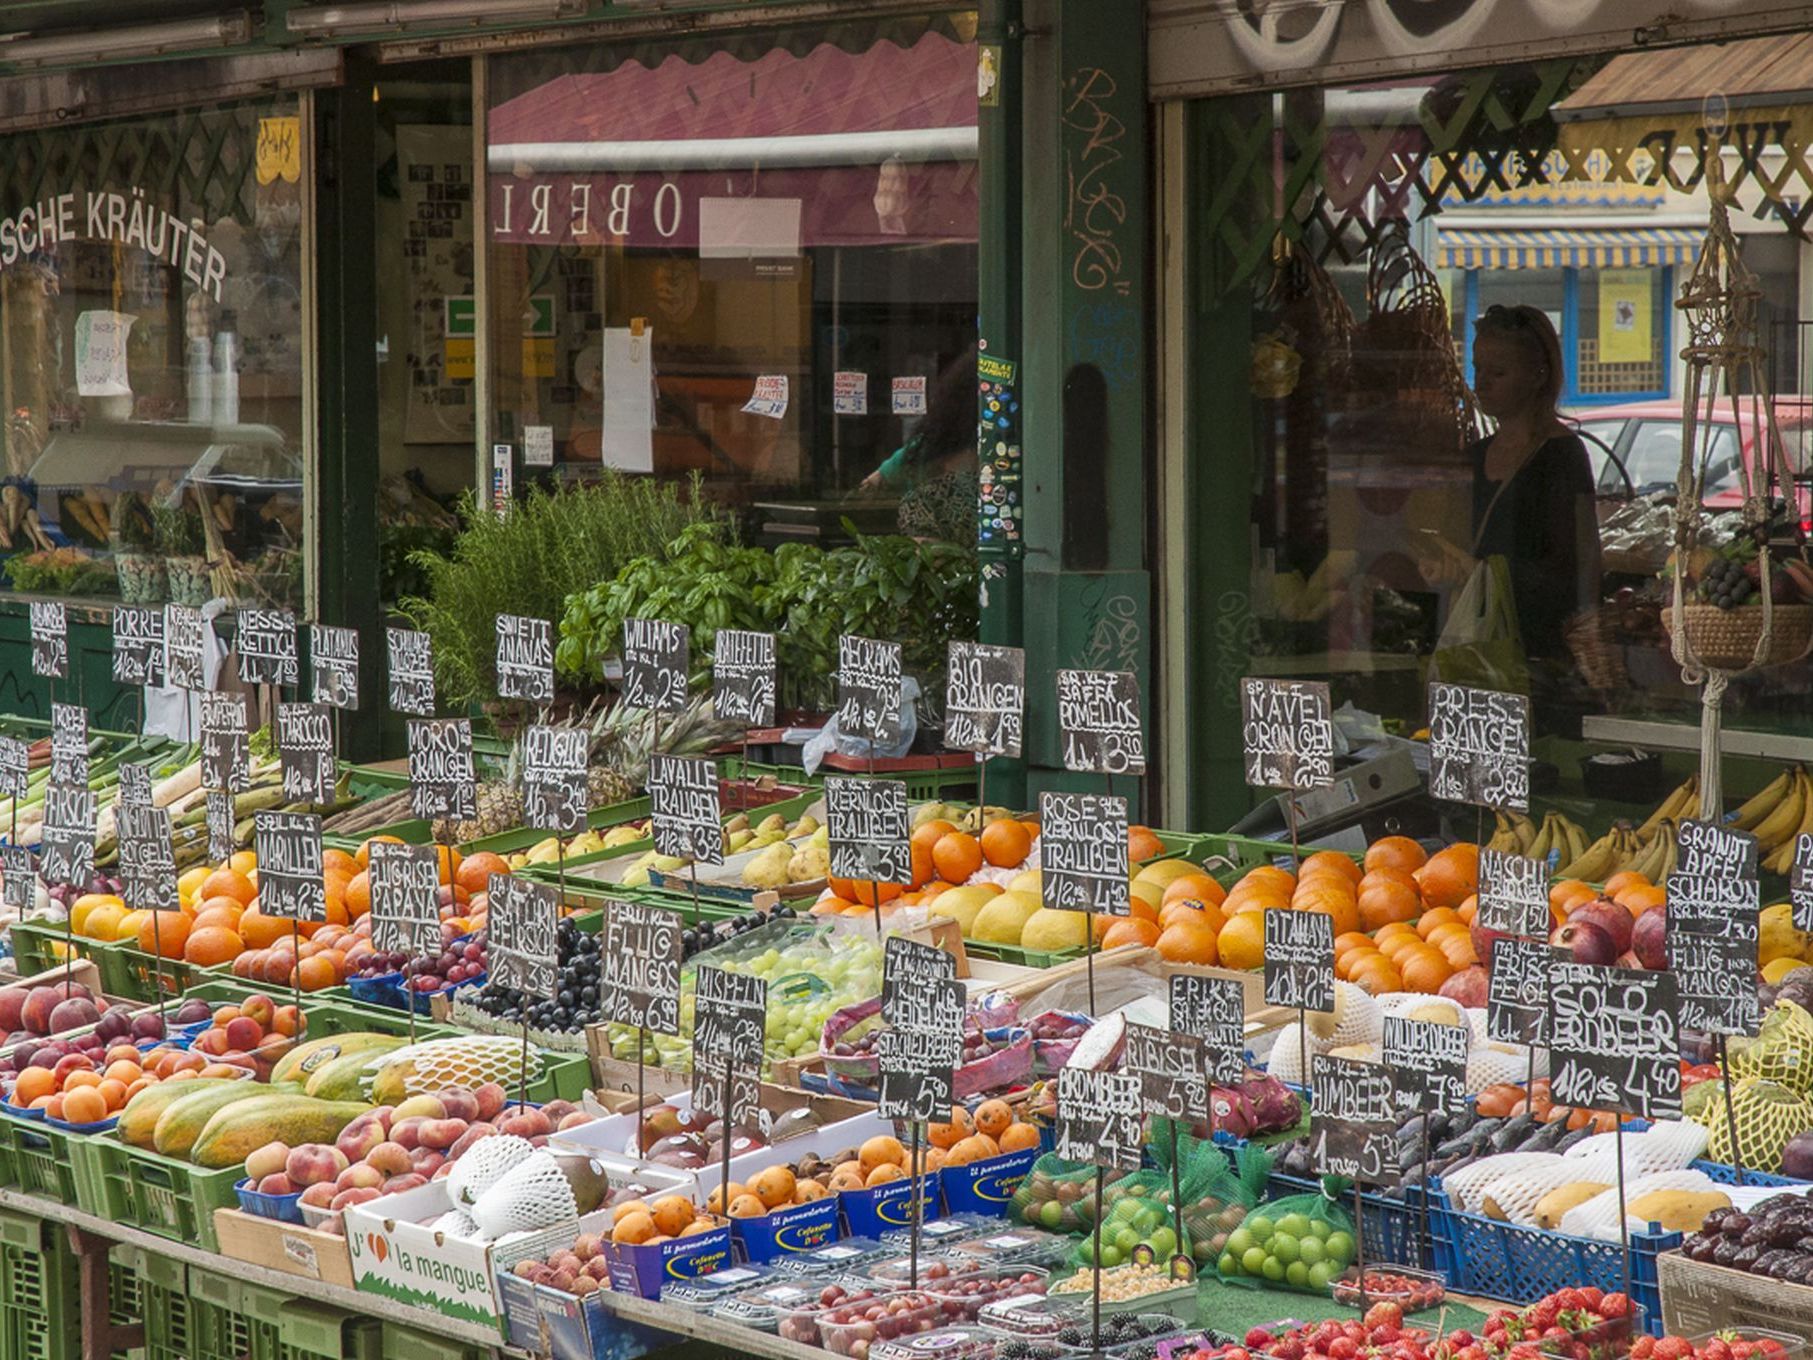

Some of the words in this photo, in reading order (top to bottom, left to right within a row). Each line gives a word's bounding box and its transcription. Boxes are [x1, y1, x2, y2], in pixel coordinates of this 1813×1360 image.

[87, 187, 227, 303] KRÄUTER
[112, 605, 163, 637] PORRE
[238, 631, 297, 657] RETTICH
[497, 635, 553, 666] ANANAS
[949, 657, 983, 687] BIO
[947, 682, 1024, 711] ORANGEN
[1059, 684, 1117, 703] JAFFA
[1249, 693, 1322, 724] NAVEL
[278, 714, 332, 748] TAROCCO
[1059, 699, 1140, 730] POMELLOS
[408, 722, 458, 751] MORO
[1431, 716, 1528, 755] ORANGEN
[409, 750, 473, 778] ORANGEN
[651, 757, 718, 791] LAVALLE
[651, 785, 721, 826] TRAUBEN
[828, 784, 906, 814] KERNLOSE
[1042, 793, 1098, 822] ROSE
[827, 808, 908, 839] TRAUBEN
[1042, 820, 1128, 844] KERNLOSE
[257, 832, 323, 876] MARILLEN
[1043, 842, 1128, 875] TRAUBEN
[1679, 821, 1751, 864] GRANAT
[1480, 849, 1546, 884] NASCHI
[373, 886, 438, 920] PAPAYA
[1667, 876, 1760, 906] SCHARON
[607, 924, 673, 960] FLUG
[603, 952, 679, 995] MANGOS
[1671, 948, 1724, 972] FLUG
[1675, 970, 1756, 998] MANGOS
[1550, 985, 1648, 1018] SOLO
[1550, 1008, 1679, 1053] ERDBEER
[1126, 1038, 1198, 1078] RIBISEL
[1058, 1066, 1142, 1113] BROMBEER
[1310, 1074, 1397, 1123] HIMBEER
[395, 1242, 413, 1273] la
[416, 1255, 493, 1295] mangue.
